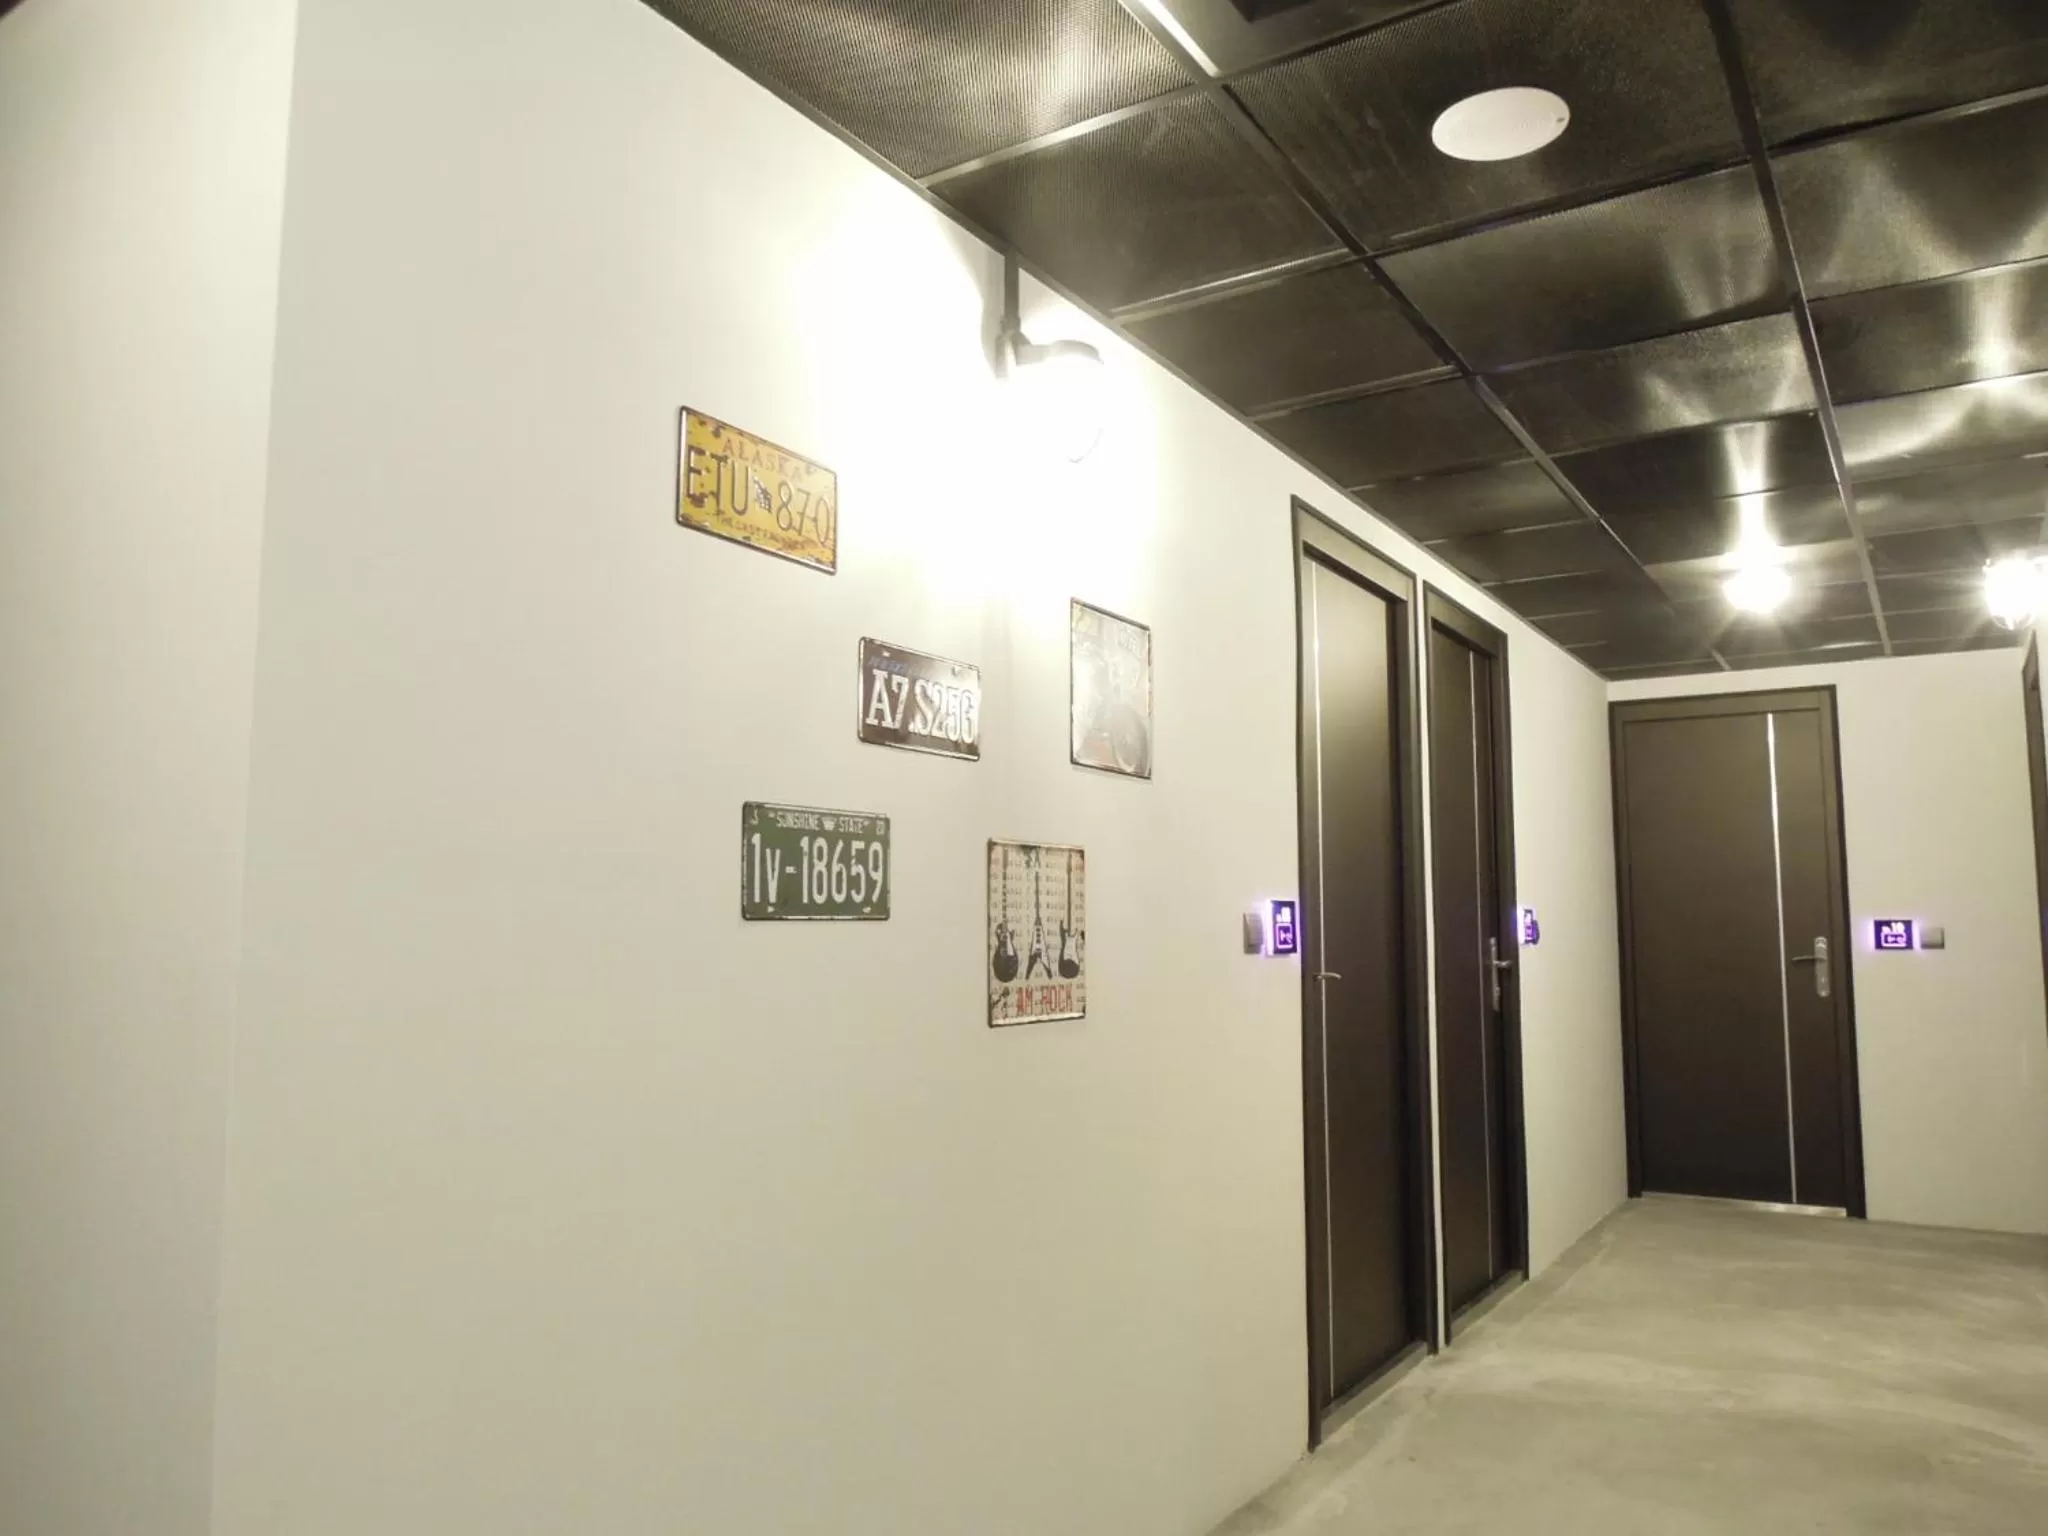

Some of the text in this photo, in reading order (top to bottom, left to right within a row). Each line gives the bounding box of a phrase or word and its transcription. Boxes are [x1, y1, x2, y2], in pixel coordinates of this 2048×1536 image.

[721, 438, 805, 480] ALASKA
[776, 479, 830, 547] 870
[838, 815, 864, 834] STATE
